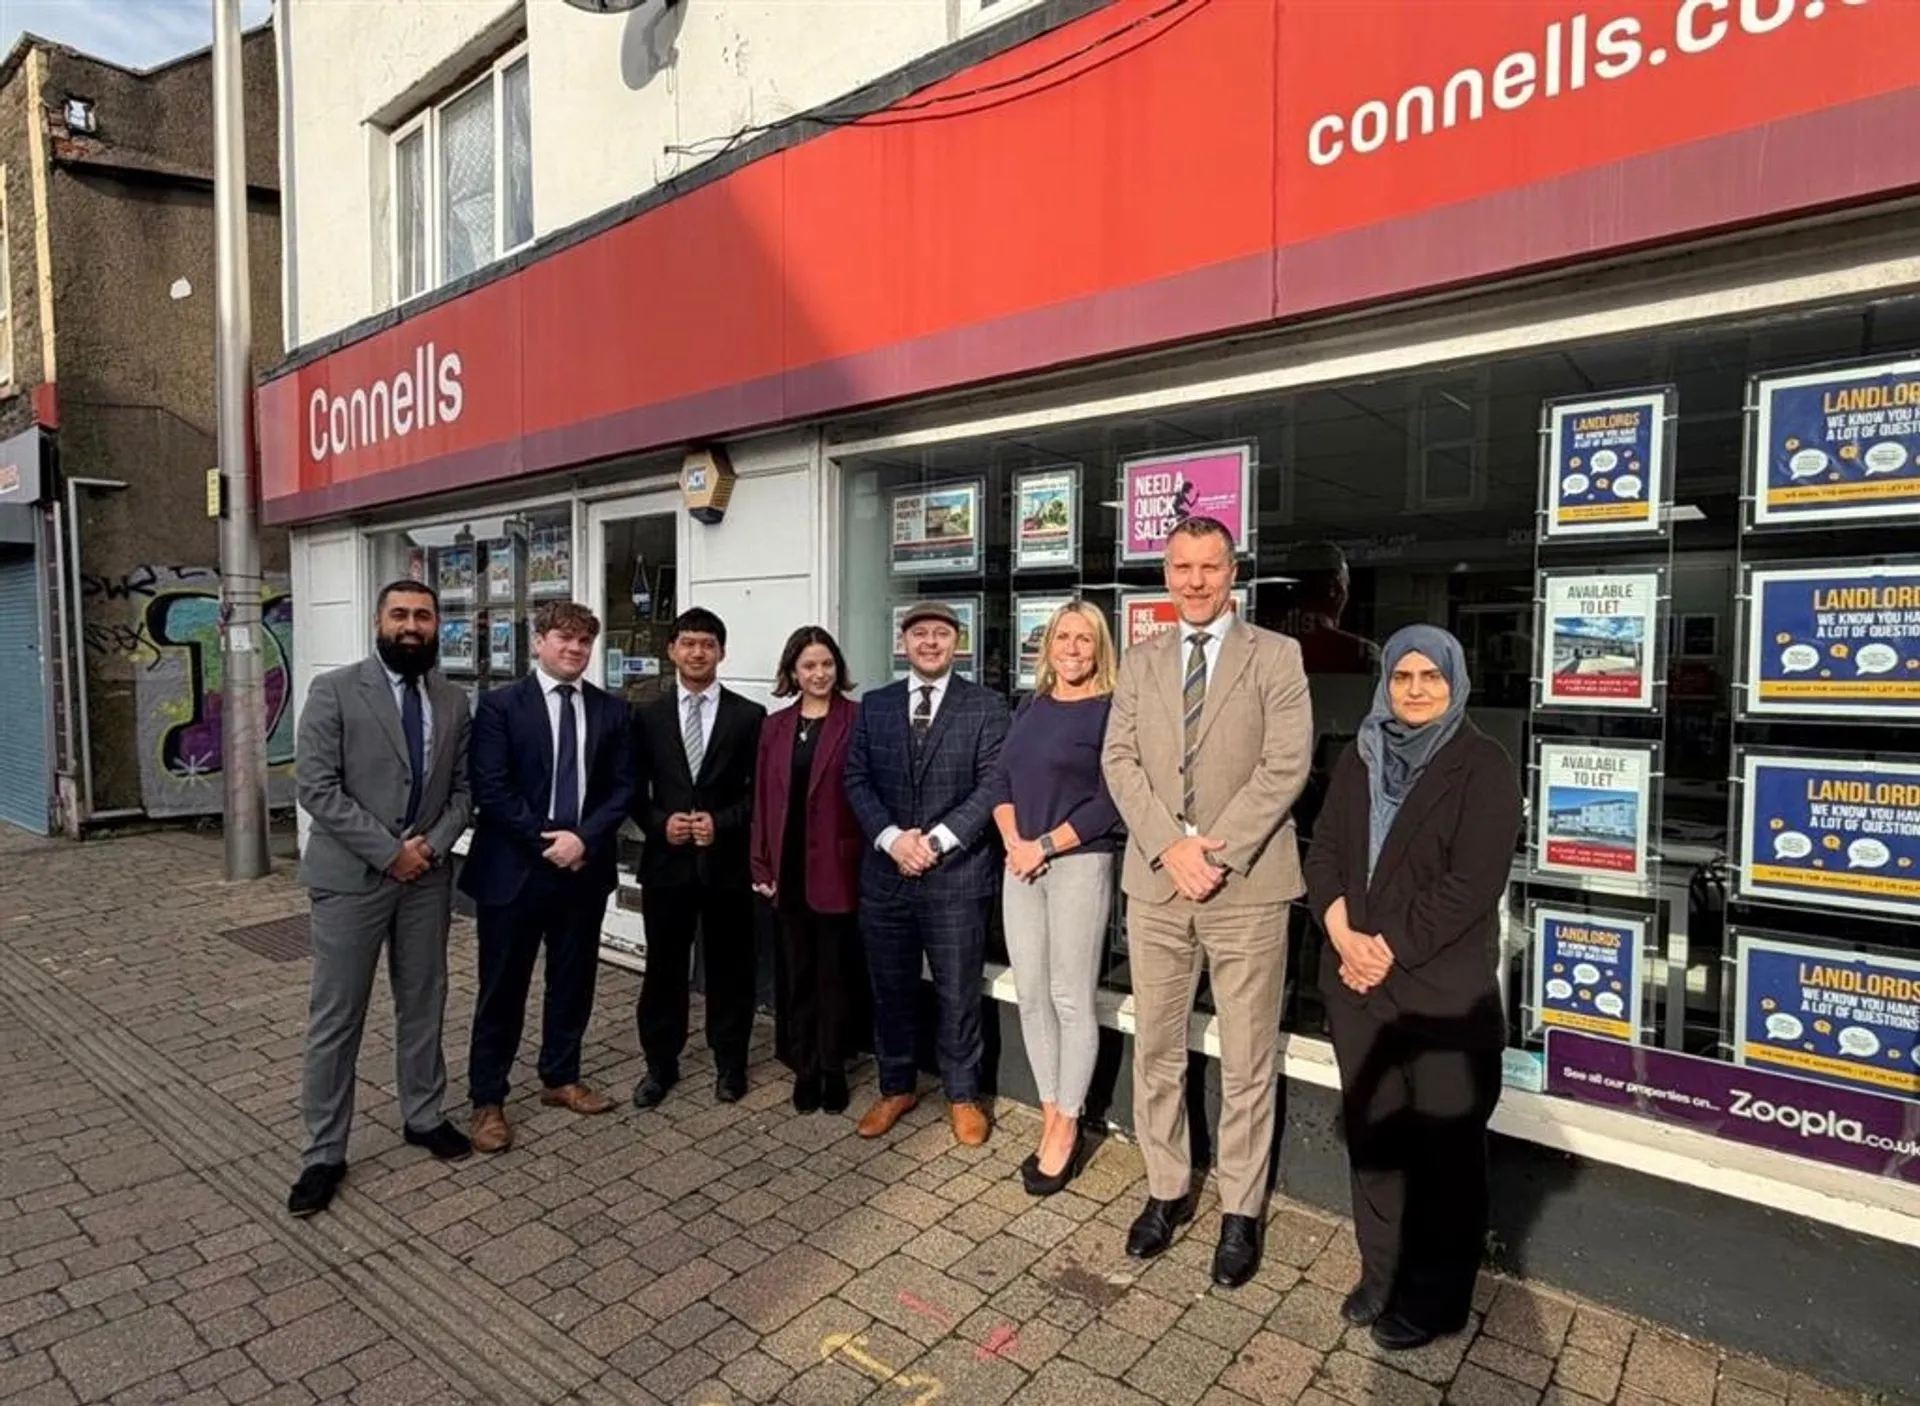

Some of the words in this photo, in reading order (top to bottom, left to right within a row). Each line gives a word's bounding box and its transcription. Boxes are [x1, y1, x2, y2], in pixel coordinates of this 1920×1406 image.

[310, 342, 463, 461] Connells
[1826, 414, 1846, 428] WE
[1848, 411, 1885, 426] KNOW
[1888, 409, 1912, 422] YOU
[1826, 429, 1835, 441] A
[1837, 427, 1859, 440] LOT
[1862, 425, 1876, 438] OF
[1135, 473, 1171, 497] NEED
[1174, 471, 1184, 492] A
[1134, 495, 1177, 519] QUICK
[1567, 584, 1634, 599] AVAILABLE
[1580, 600, 1595, 614] TO
[1597, 600, 1620, 614] LET
[1817, 613, 1836, 626] WE
[1839, 611, 1875, 625] KNOW
[1877, 611, 1901, 623] YOU
[1816, 627, 1826, 638] A
[1828, 626, 1849, 638] LOT
[1852, 625, 1866, 637] OF
[1562, 756, 1628, 772] AVAILABLE
[1574, 771, 1589, 785] TO
[1592, 772, 1614, 787] LET
[1810, 804, 1829, 816] WE
[1832, 804, 1867, 819] KNOW
[1870, 807, 1893, 821] YOU
[1809, 816, 1818, 828] A
[1820, 817, 1842, 829] LOT
[1844, 819, 1859, 831] OF
[1802, 987, 1820, 999] WE
[1823, 990, 1858, 1006] KNOW
[1861, 996, 1884, 1011] YOU
[1887, 1001, 1920, 1017] HAVE
[1801, 1000, 1810, 1012] A
[1812, 1003, 1833, 1016] LOT
[1835, 1006, 1850, 1018] OF
[1853, 1009, 1920, 1031] QUESTIONS
[1563, 1066, 1587, 1081] See
[1588, 1073, 1602, 1085] all
[1603, 1076, 1626, 1090] our
[1626, 1080, 1691, 1105] properties
